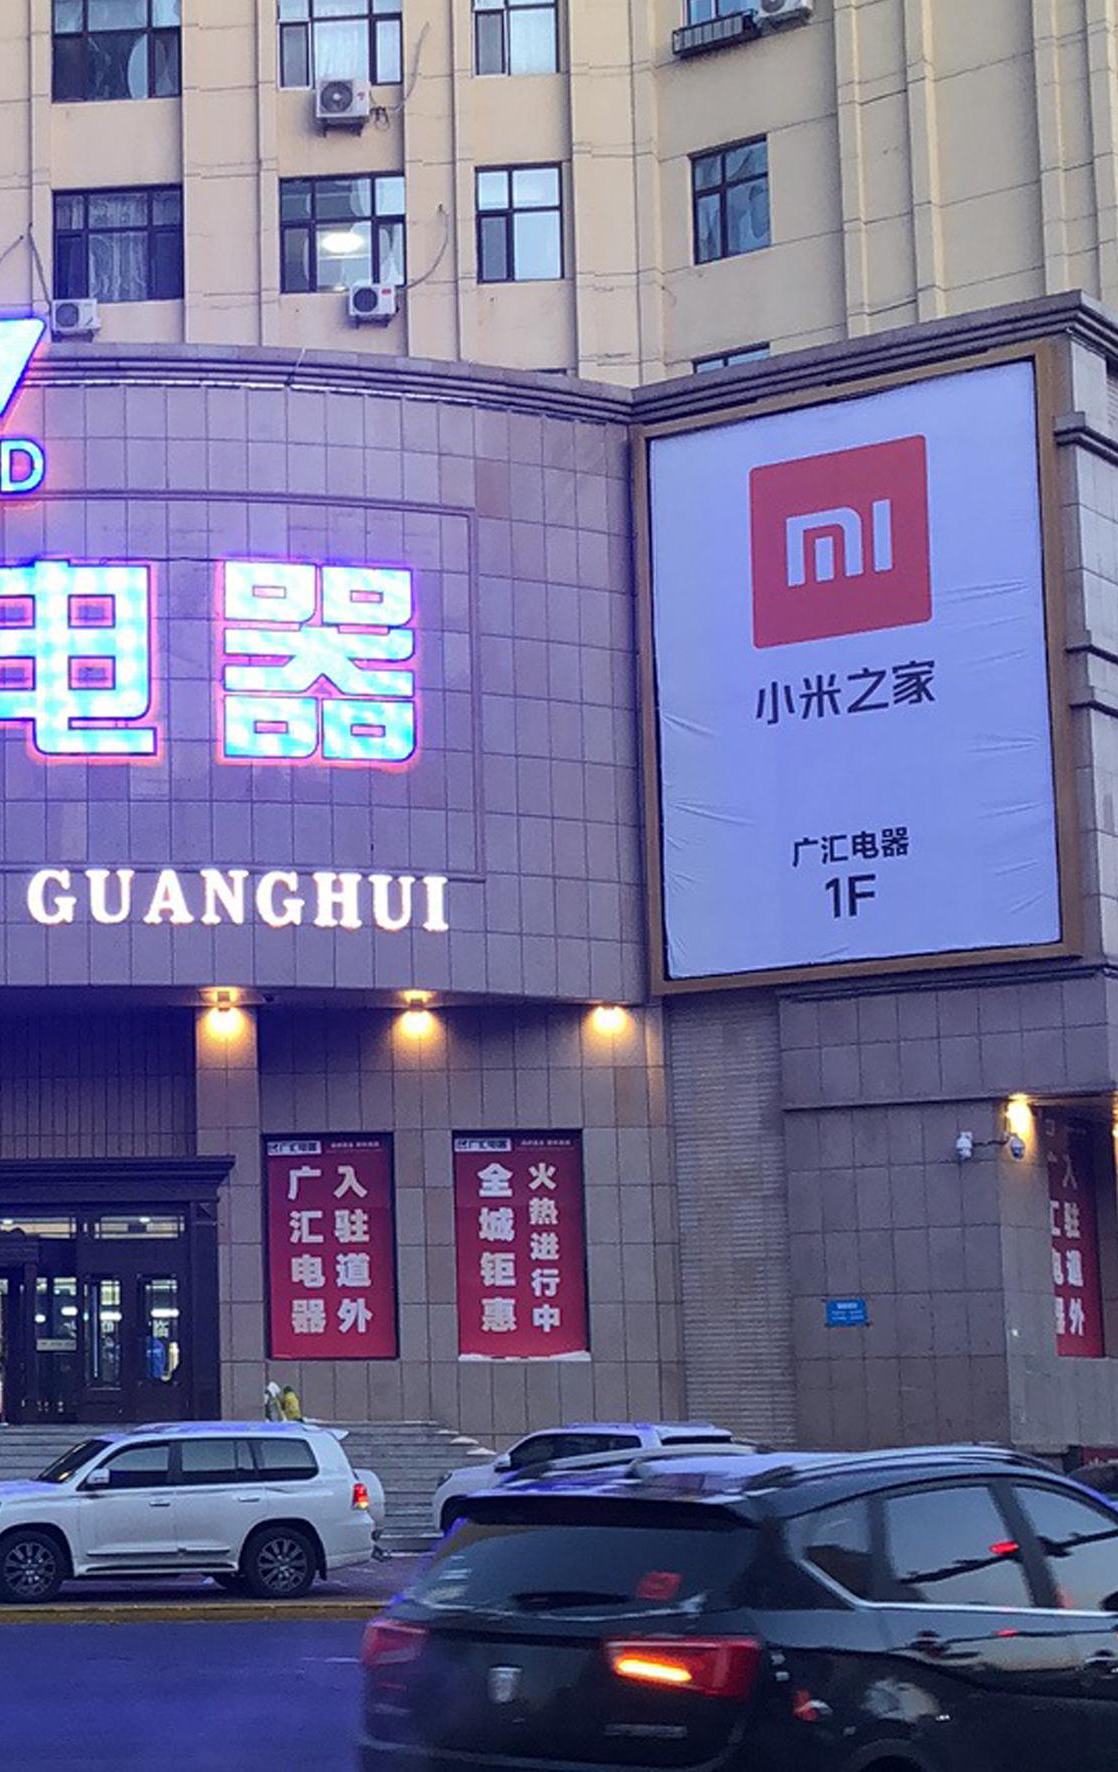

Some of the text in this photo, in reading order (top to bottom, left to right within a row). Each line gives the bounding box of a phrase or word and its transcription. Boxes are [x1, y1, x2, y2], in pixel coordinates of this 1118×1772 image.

[755, 659, 937, 726] 小米之家
[26, 866, 451, 934] GUANGHUI
[792, 825, 911, 868] 广汇电器
[824, 873, 878, 919] 1F
[287, 1165, 327, 1334] 广汇电器
[333, 1165, 373, 1334] 入驻道外
[477, 1163, 517, 1332] 全城钜惠
[528, 1162, 561, 1332] 火热进行中
